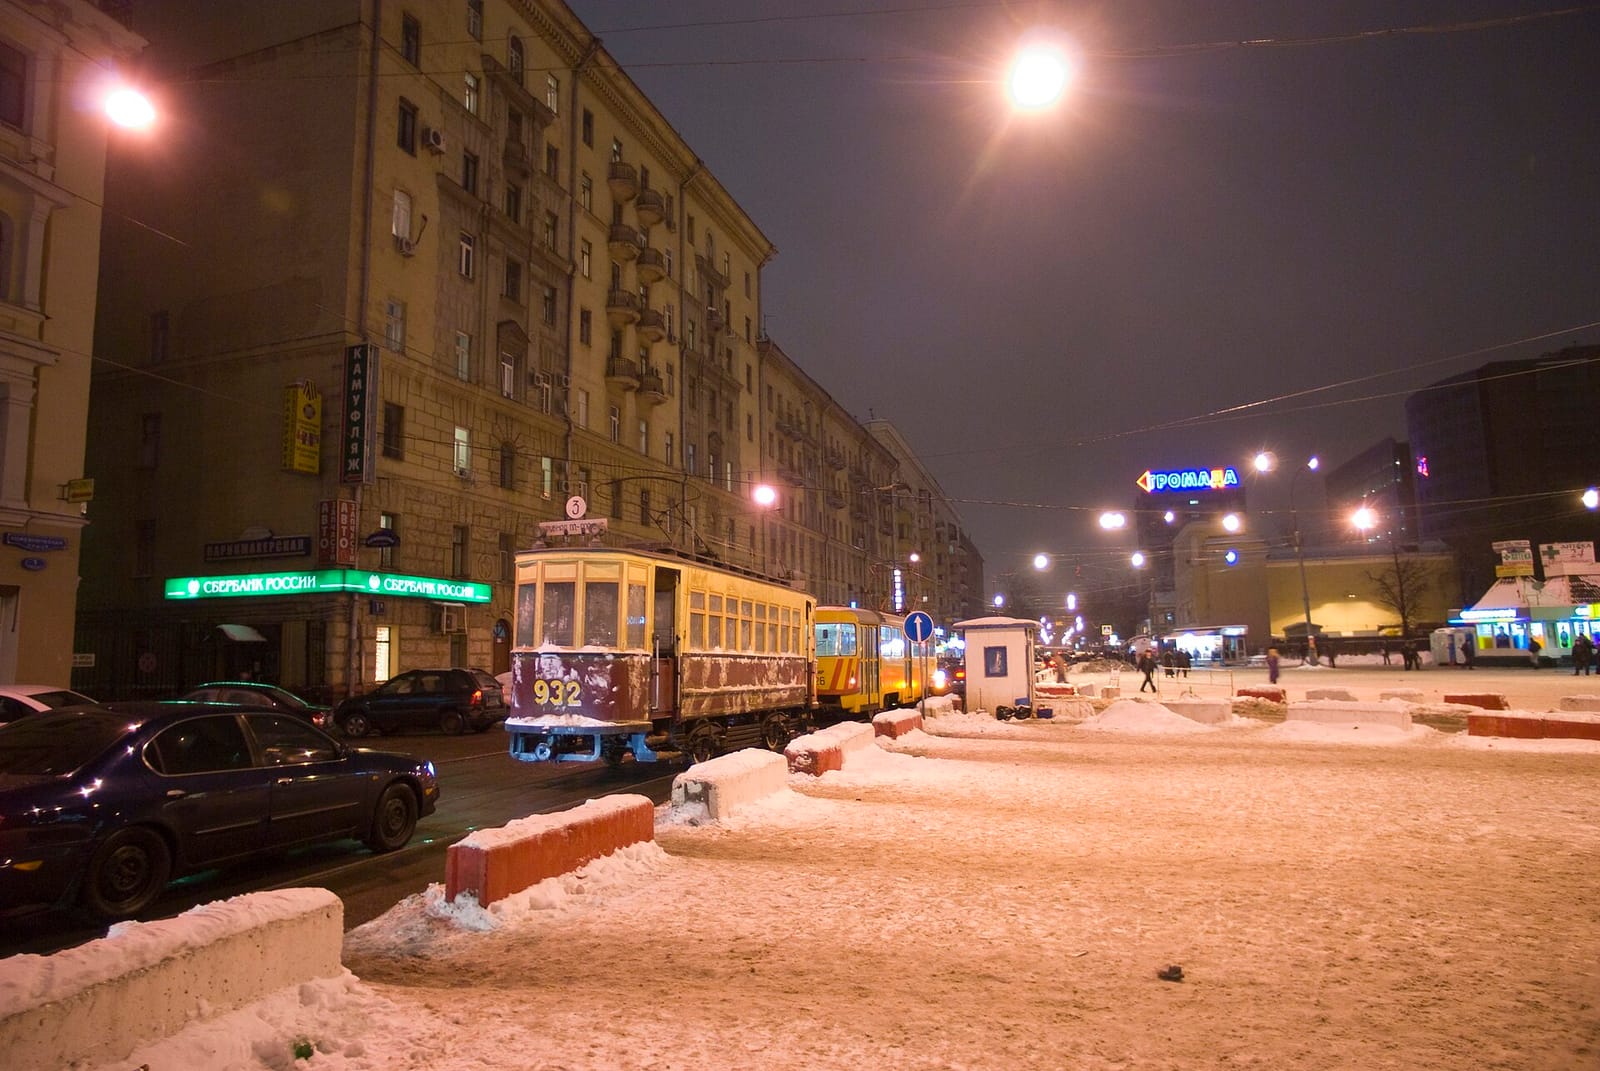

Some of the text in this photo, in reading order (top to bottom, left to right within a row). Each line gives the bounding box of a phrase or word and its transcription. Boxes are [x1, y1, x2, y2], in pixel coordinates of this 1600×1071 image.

[348, 347, 362, 472] КАМУФЛЯЖ
[1146, 469, 1238, 489] ГРОМАДА
[320, 502, 331, 549] АВТО
[339, 502, 349, 549] АВТО
[203, 576, 316, 593] СБЕРБАНК РОССИИ
[383, 579, 475, 597] СБЕРБАНК РОССИИ
[533, 680, 581, 706] 932
